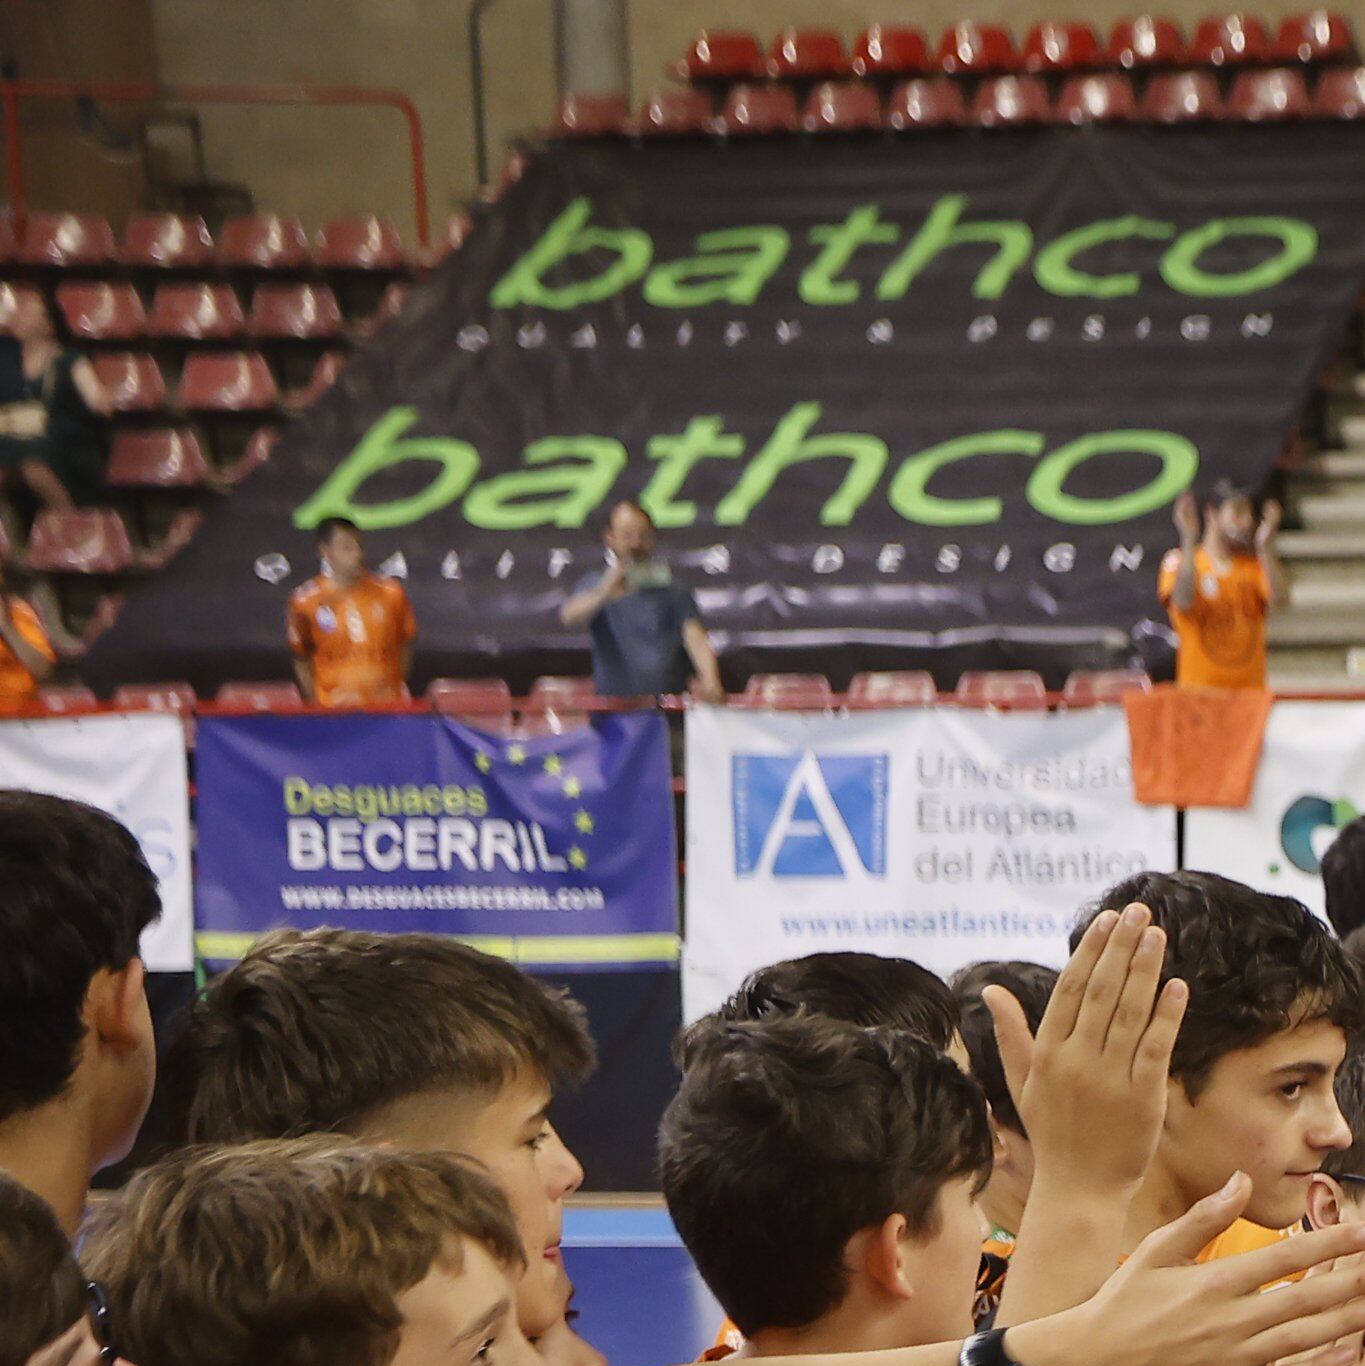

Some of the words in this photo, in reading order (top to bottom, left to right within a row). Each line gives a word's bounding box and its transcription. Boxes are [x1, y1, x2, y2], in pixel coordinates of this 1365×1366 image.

[490, 197, 1319, 310] bathco
[968, 313, 1275, 345] DESIGN
[293, 402, 1200, 531] bathco
[811, 543, 1145, 574] DESIGN
[283, 777, 488, 824] Desguaces
[915, 801, 1078, 838] Europea
[287, 818, 568, 873] BECERRIL
[915, 848, 973, 884] del
[985, 848, 1148, 886] Atlántico
